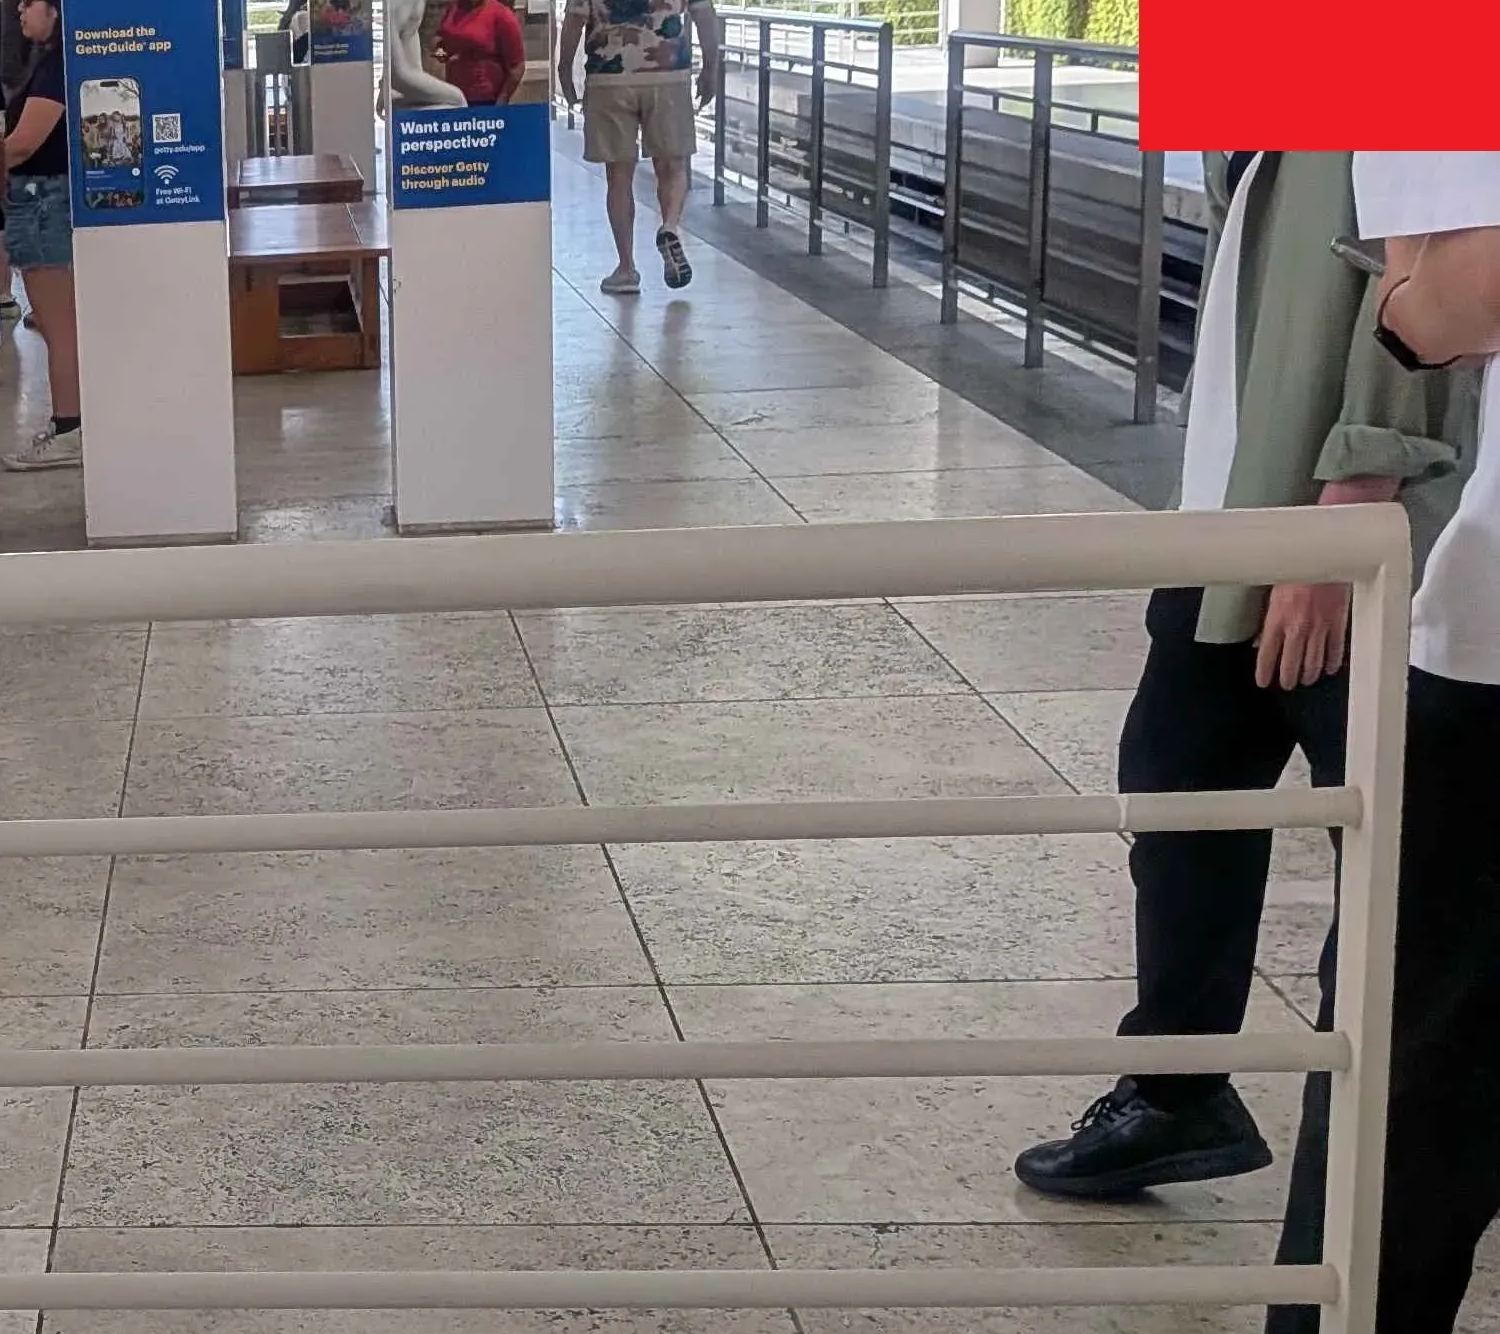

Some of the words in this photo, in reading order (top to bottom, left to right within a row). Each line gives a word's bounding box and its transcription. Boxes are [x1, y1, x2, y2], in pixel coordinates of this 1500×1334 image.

[75, 27, 134, 41] Download
[136, 26, 156, 37] the
[148, 41, 172, 52] app
[400, 121, 439, 135] Want
[441, 122, 451, 132] a
[453, 117, 505, 133] unique
[401, 134, 497, 155] perspective?
[401, 163, 454, 176] Discover
[455, 161, 490, 173] Getty
[402, 176, 449, 190] through
[451, 174, 486, 187] audio
